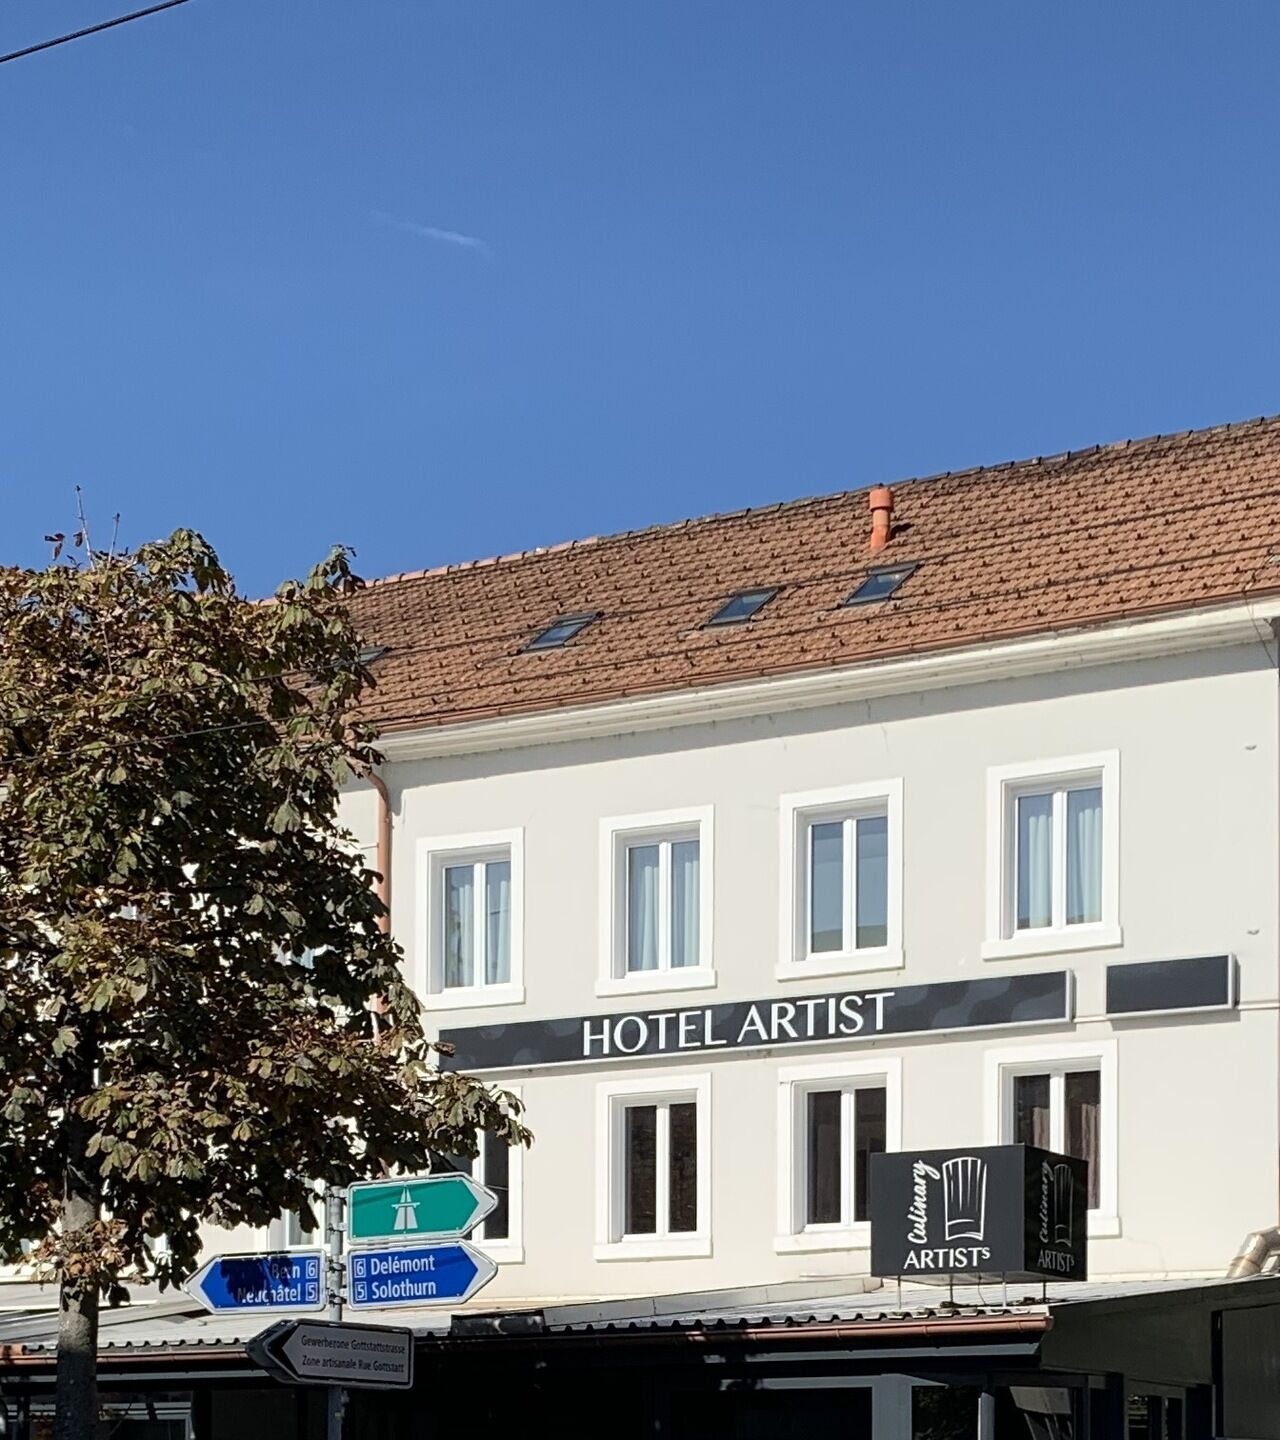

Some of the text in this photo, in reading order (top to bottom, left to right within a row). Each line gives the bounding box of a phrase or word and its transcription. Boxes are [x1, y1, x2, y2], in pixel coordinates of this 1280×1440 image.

[583, 992, 895, 1056] HOTEL ARTIST
[907, 1160, 941, 1244] Culinary
[1039, 1160, 1054, 1243] Culinary
[308, 1262, 317, 1277] 6
[356, 1254, 435, 1276] 6 Delémont
[308, 1285, 317, 1299] 5
[357, 1279, 436, 1299] 5 Solothurn
[301, 1335, 405, 1354] Gewerbezone Gottstattstrasse
[302, 1355, 404, 1373] Zone artisanale Rue Gottstatt
